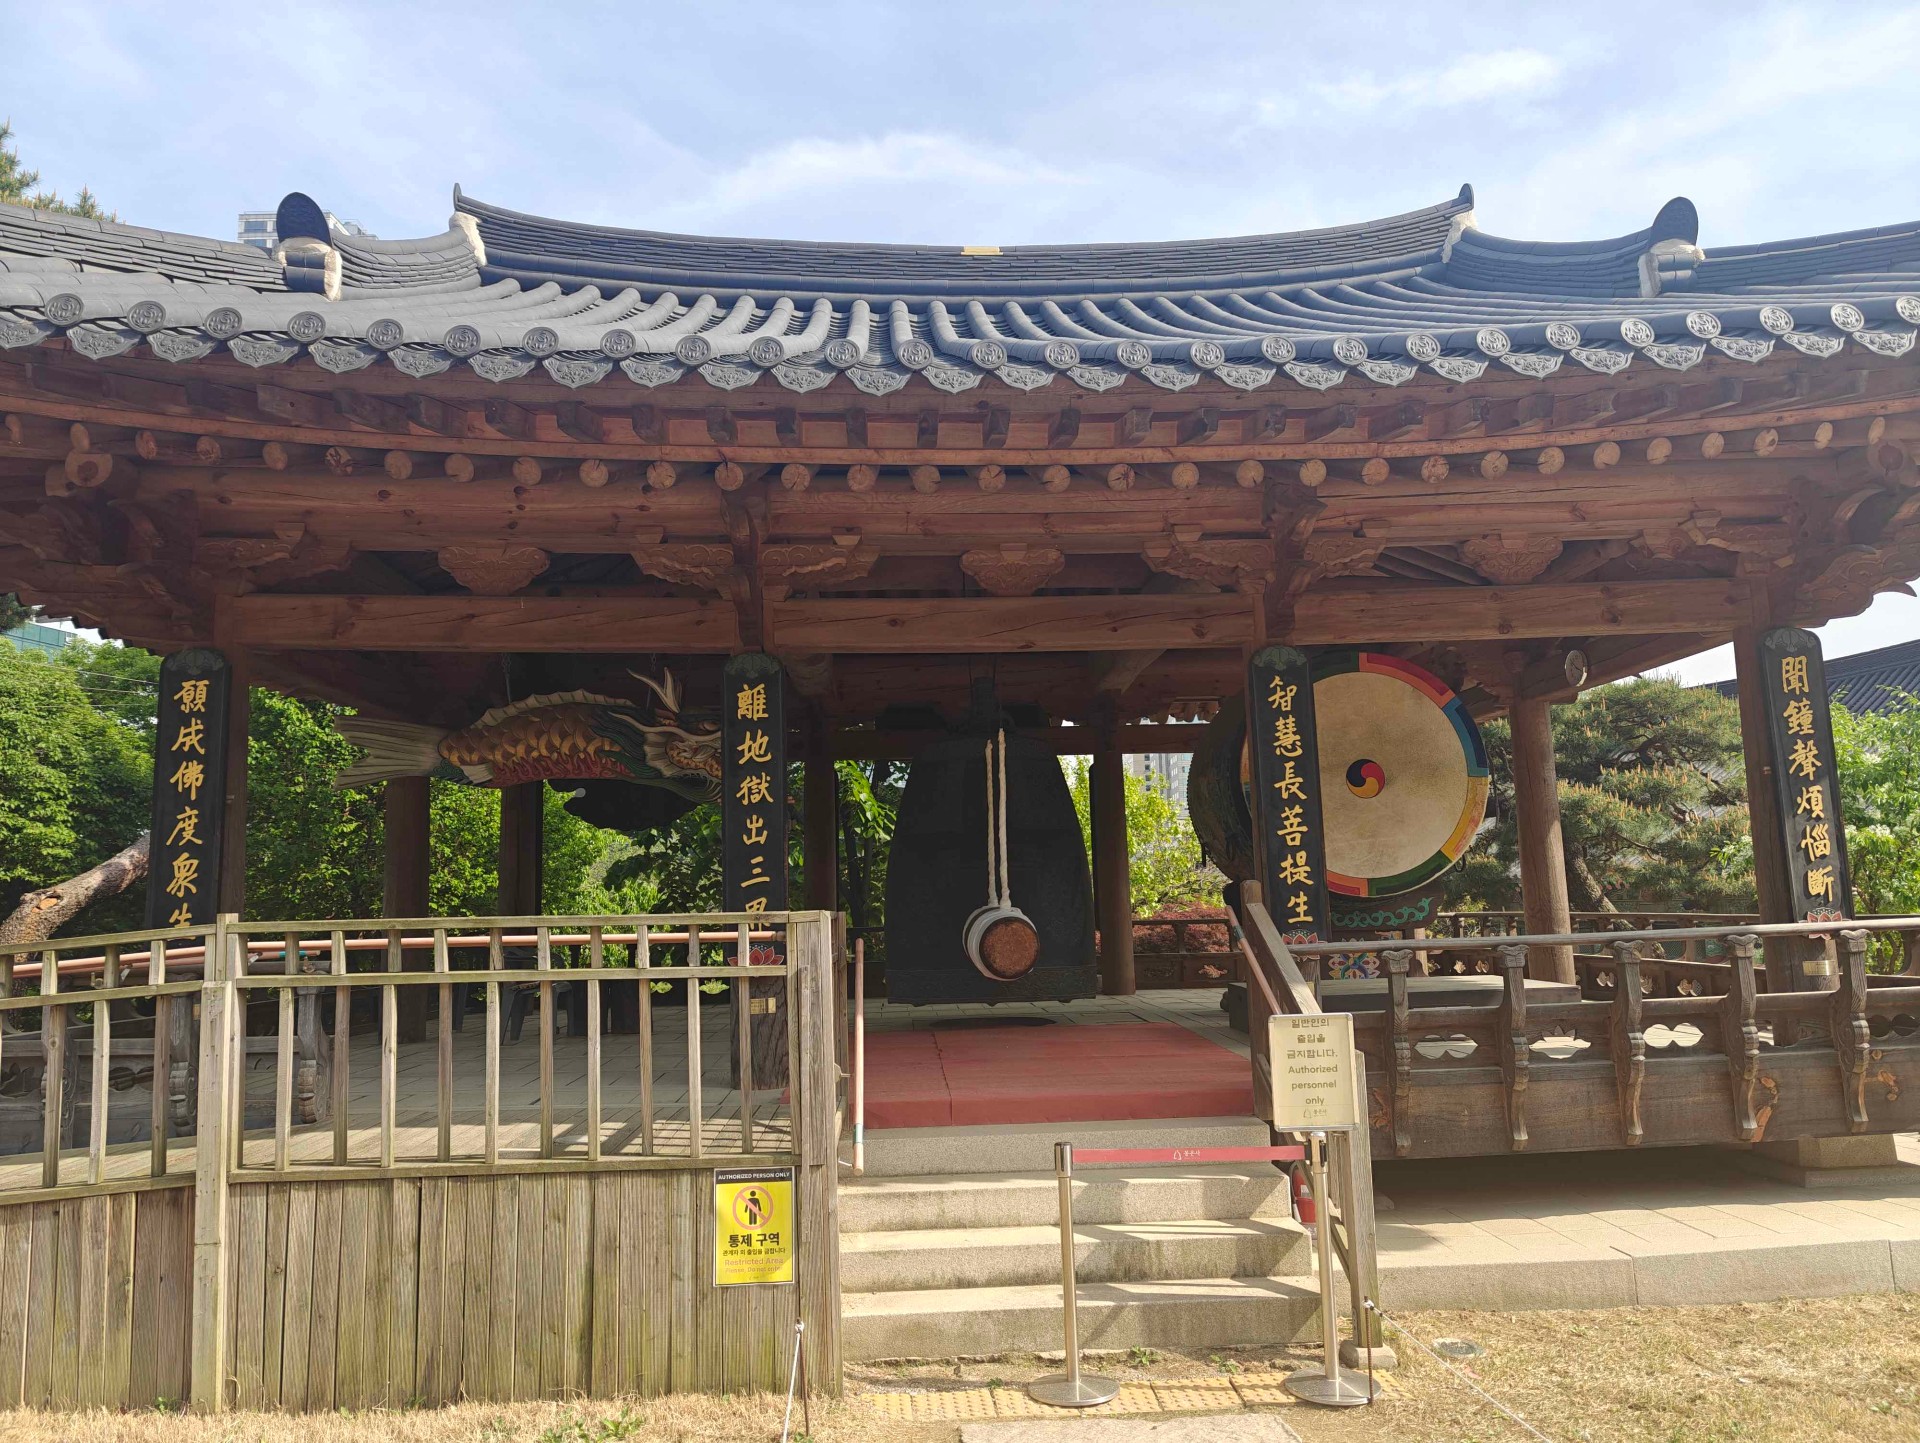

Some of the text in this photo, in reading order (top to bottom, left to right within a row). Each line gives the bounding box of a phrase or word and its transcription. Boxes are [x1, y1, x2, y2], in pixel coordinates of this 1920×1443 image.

[1780, 655, 1834, 902] 聞鐘聲煩惱斷
[1267, 675, 1315, 924] 智慧長菩提生
[1291, 1018, 1330, 1028] 일반인의
[1297, 1034, 1326, 1043] 출입을
[1287, 1049, 1338, 1059] 금지합니다.
[1288, 1064, 1338, 1074] Authorized
[1291, 1080, 1337, 1091] personnel
[1305, 1096, 1325, 1106] only
[728, 1232, 780, 1248] 통제 구역
[725, 1257, 784, 1266] Restricted Area
